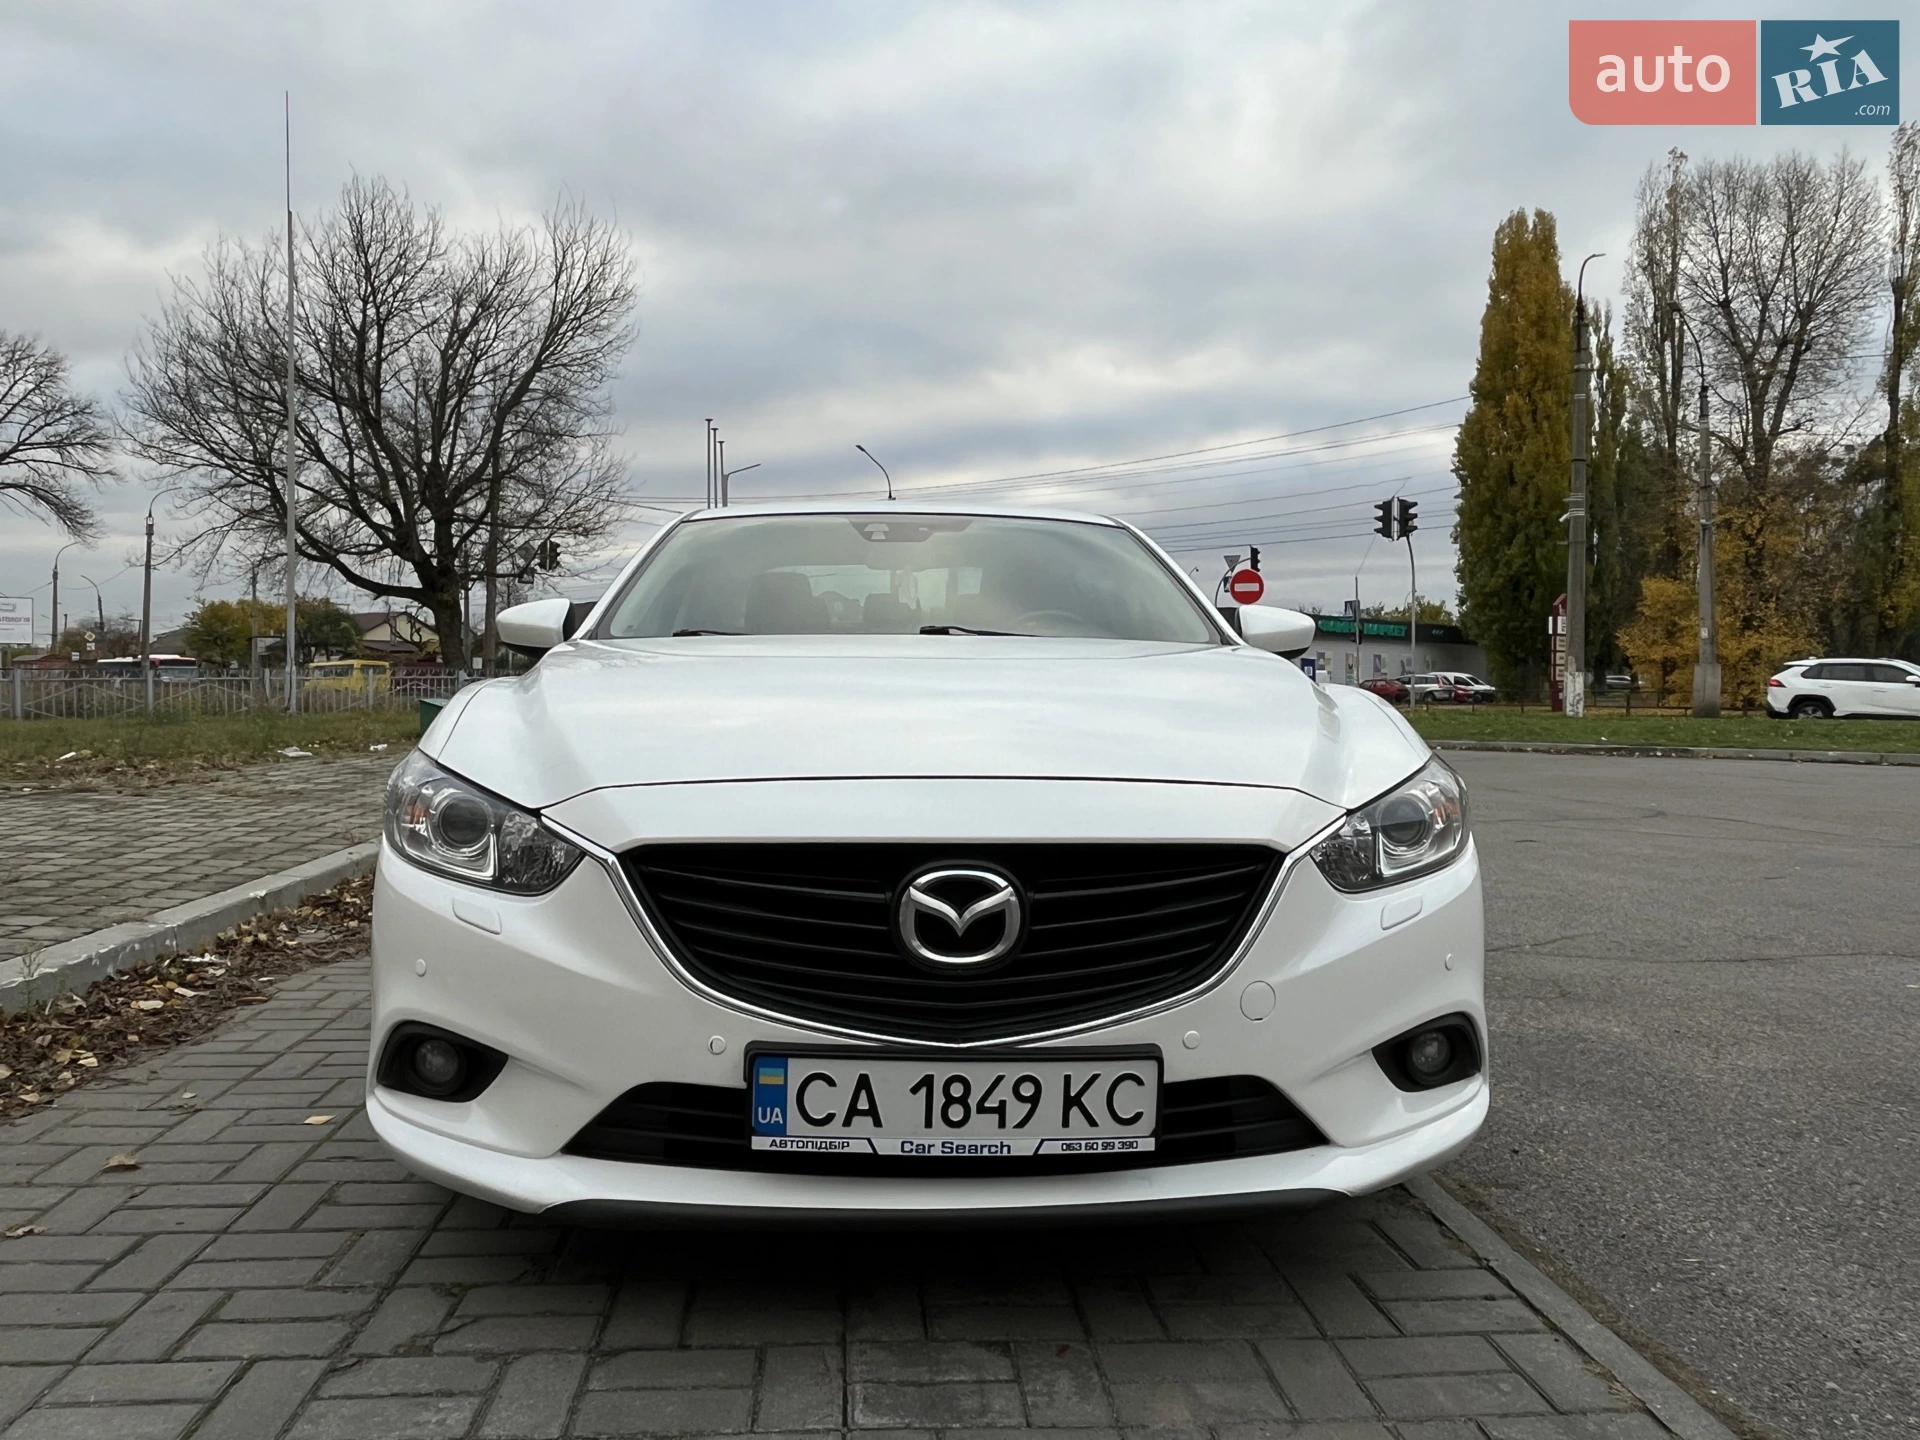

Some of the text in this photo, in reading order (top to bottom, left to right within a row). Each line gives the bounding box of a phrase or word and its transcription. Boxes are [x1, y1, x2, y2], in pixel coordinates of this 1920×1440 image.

[796, 1071, 1145, 1129] CA 1849 KC
[757, 1107, 784, 1124] UA
[769, 1138, 850, 1151] АВТОПІДБІР
[900, 1140, 1011, 1155] Car Search
[1061, 1140, 1138, 1152] 063 60 99 390
